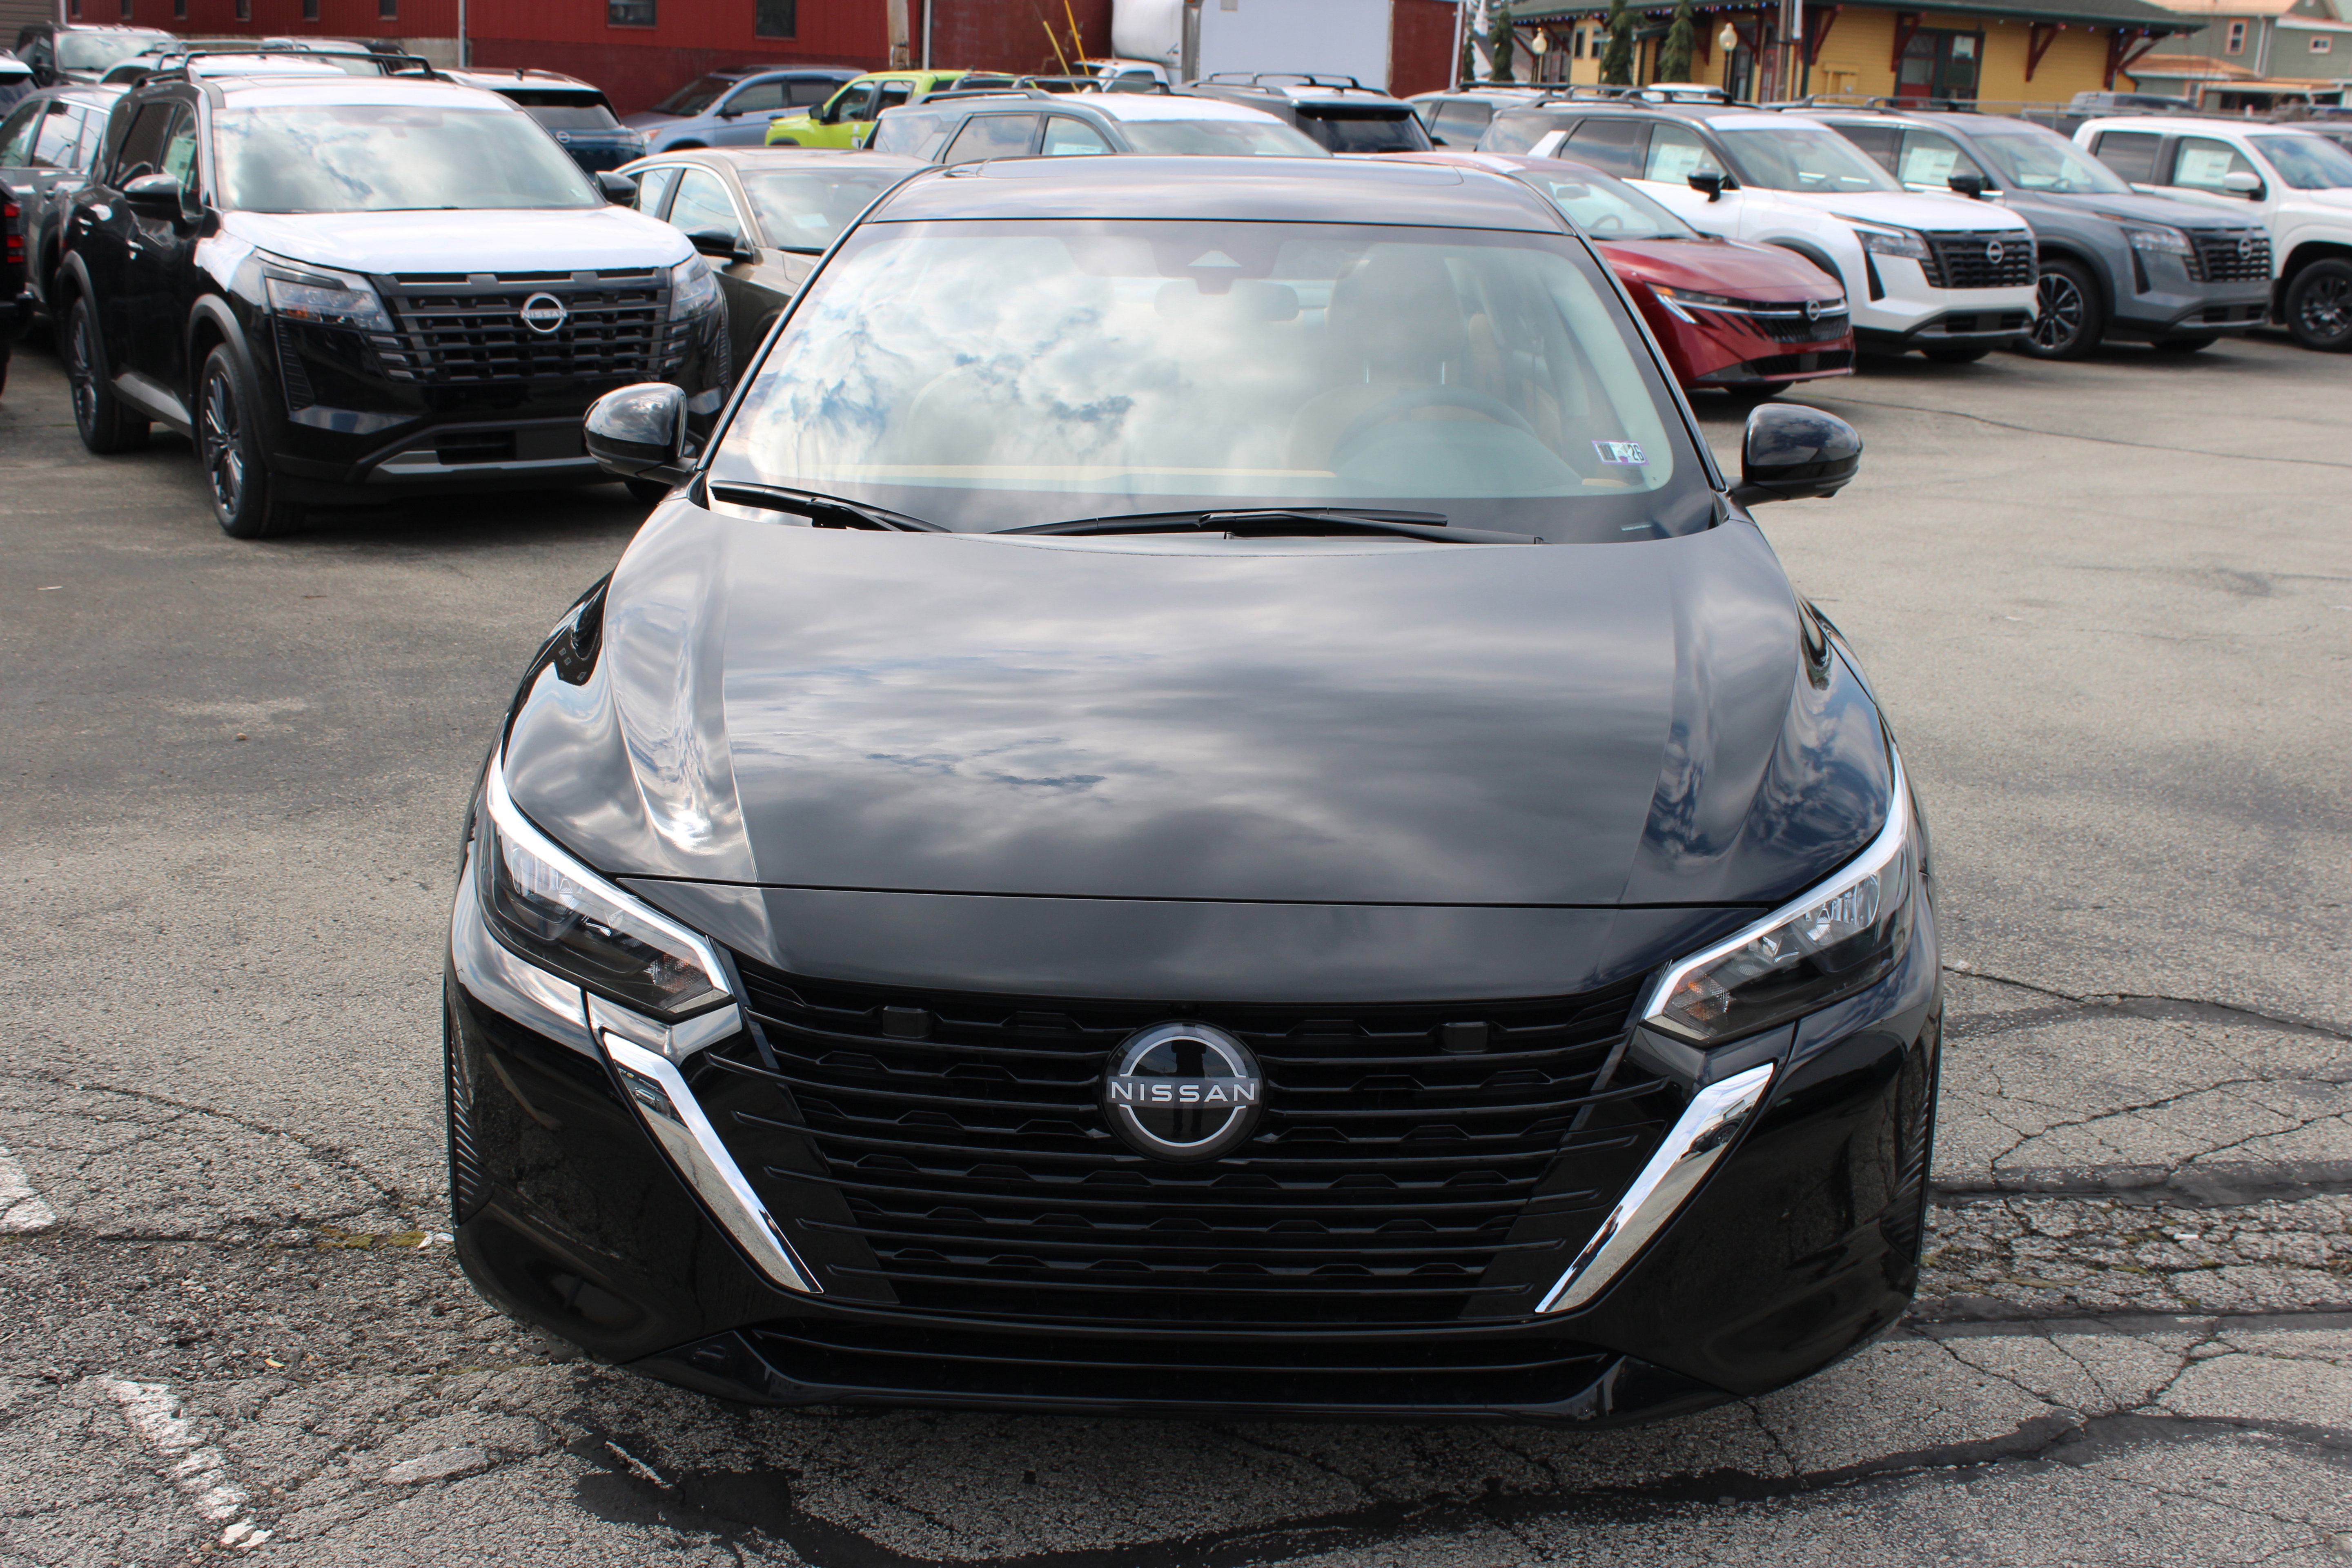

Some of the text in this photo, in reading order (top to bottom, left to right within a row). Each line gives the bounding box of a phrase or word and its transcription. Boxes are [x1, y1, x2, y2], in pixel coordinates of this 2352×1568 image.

[521, 310, 567, 318] NISSAN
[1598, 444, 1645, 461] 10 26
[1111, 1081, 1255, 1102] NISSAN
